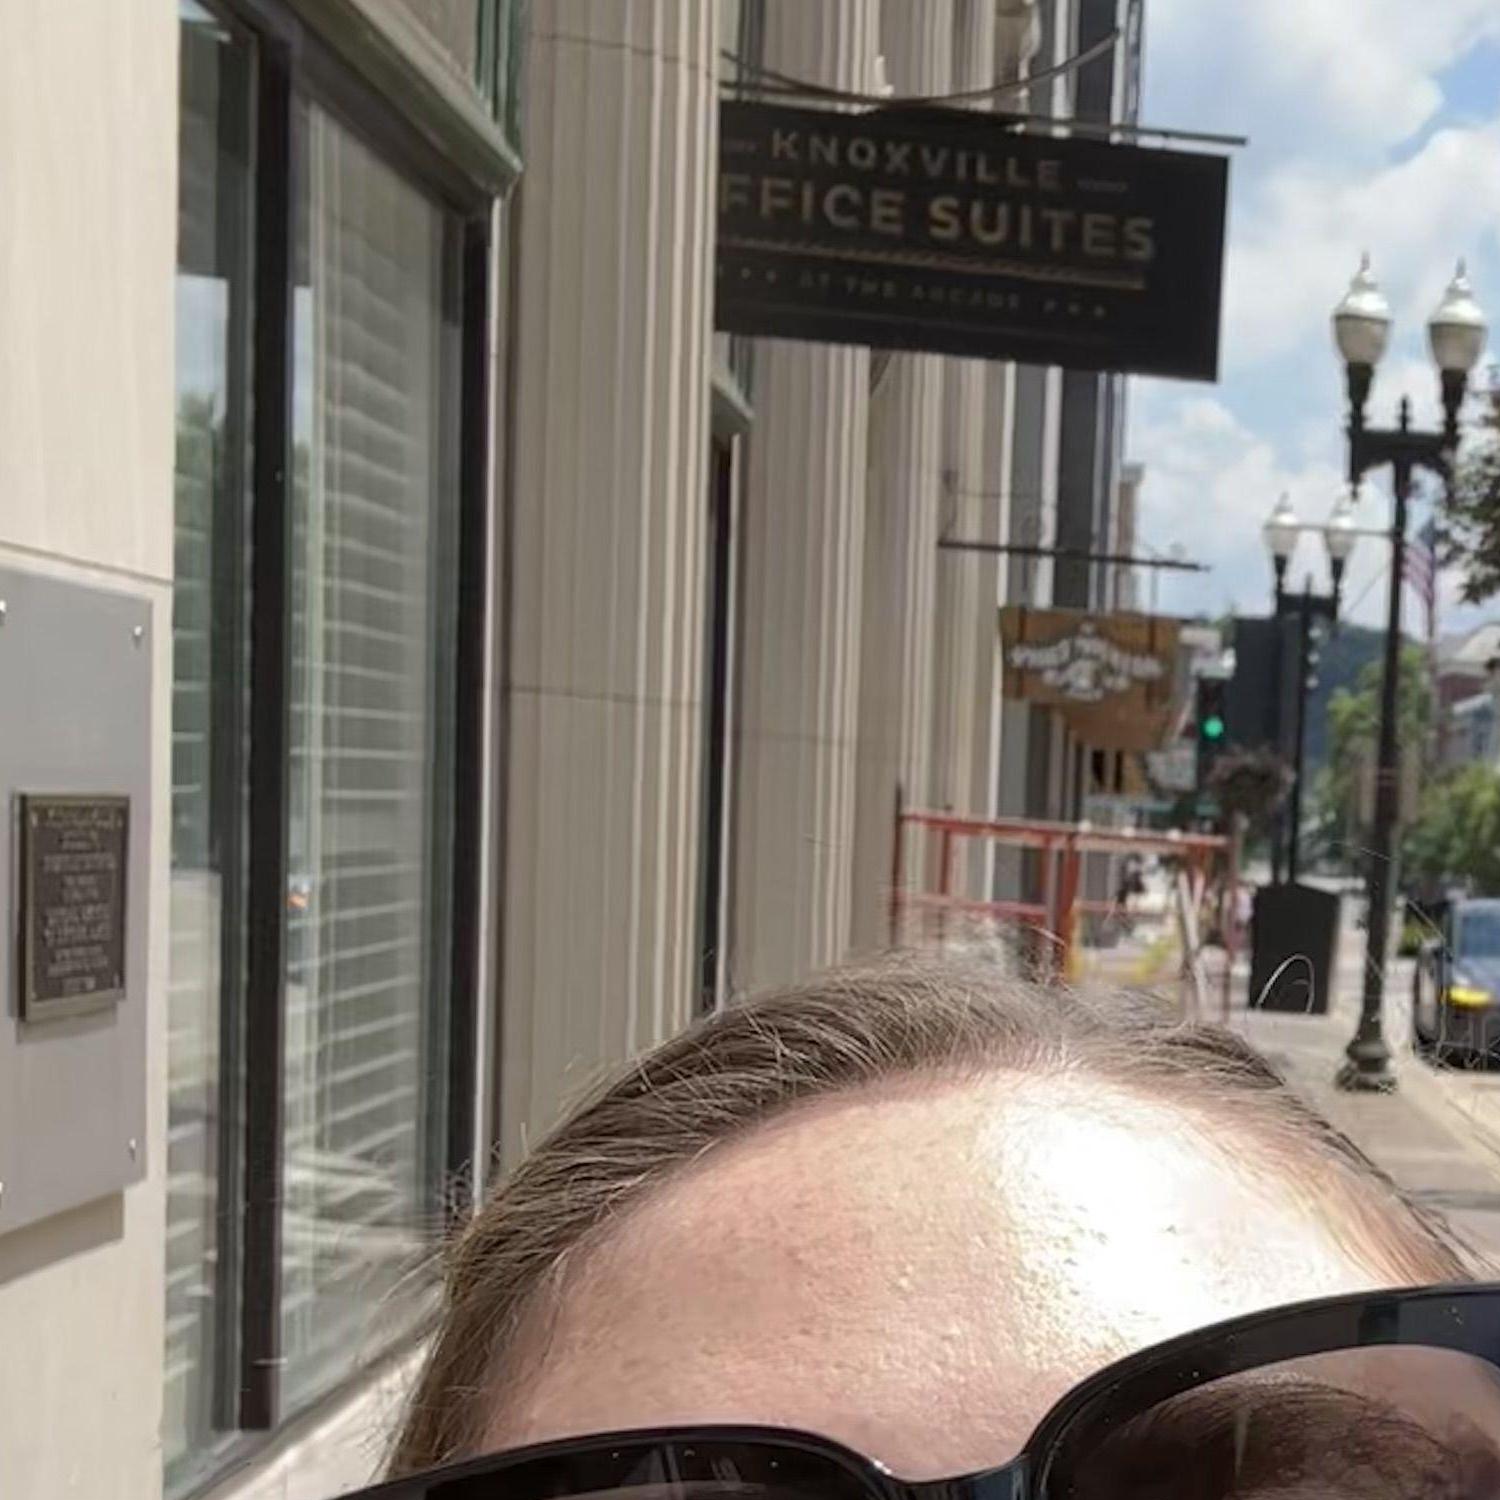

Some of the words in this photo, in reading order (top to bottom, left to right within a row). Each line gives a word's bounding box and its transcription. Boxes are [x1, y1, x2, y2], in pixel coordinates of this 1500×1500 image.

[771, 128, 1064, 192] KNOXVILLE
[720, 173, 906, 235] FFICE
[928, 195, 1157, 261] SUITES
